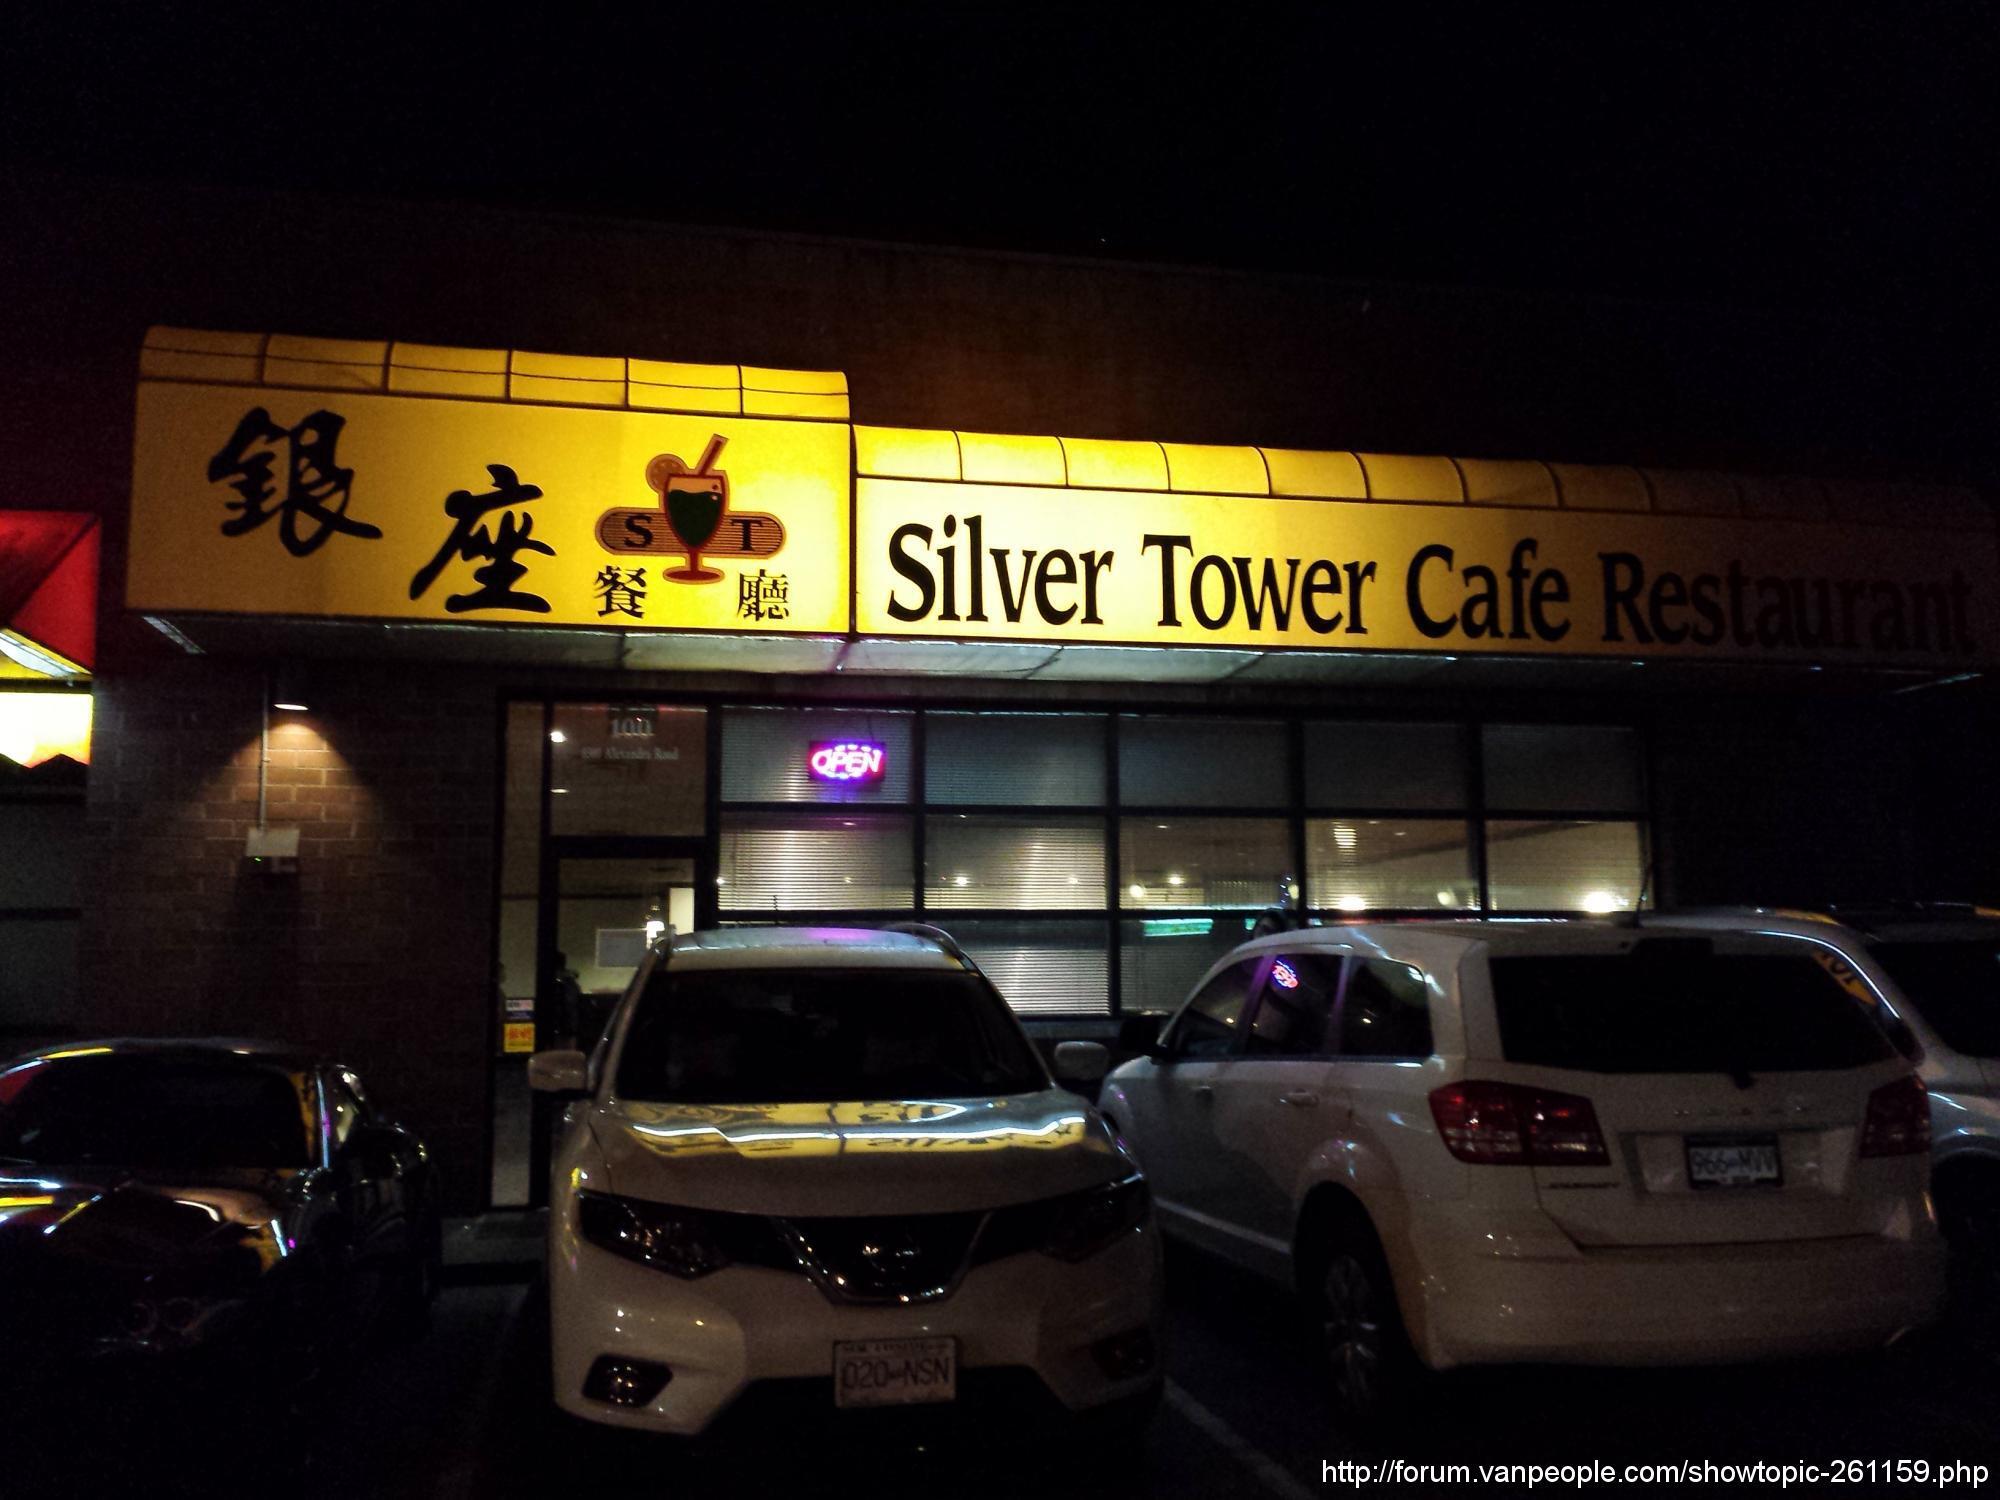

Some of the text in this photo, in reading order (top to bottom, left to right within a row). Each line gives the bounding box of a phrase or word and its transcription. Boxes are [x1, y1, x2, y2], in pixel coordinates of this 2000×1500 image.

[208, 408, 557, 622] 銀座
[624, 513, 763, 551] S T
[594, 565, 791, 622] 餐廳
[887, 514, 1974, 654] Silver Tower Cafe Restaurant
[811, 744, 884, 779] OPEN
